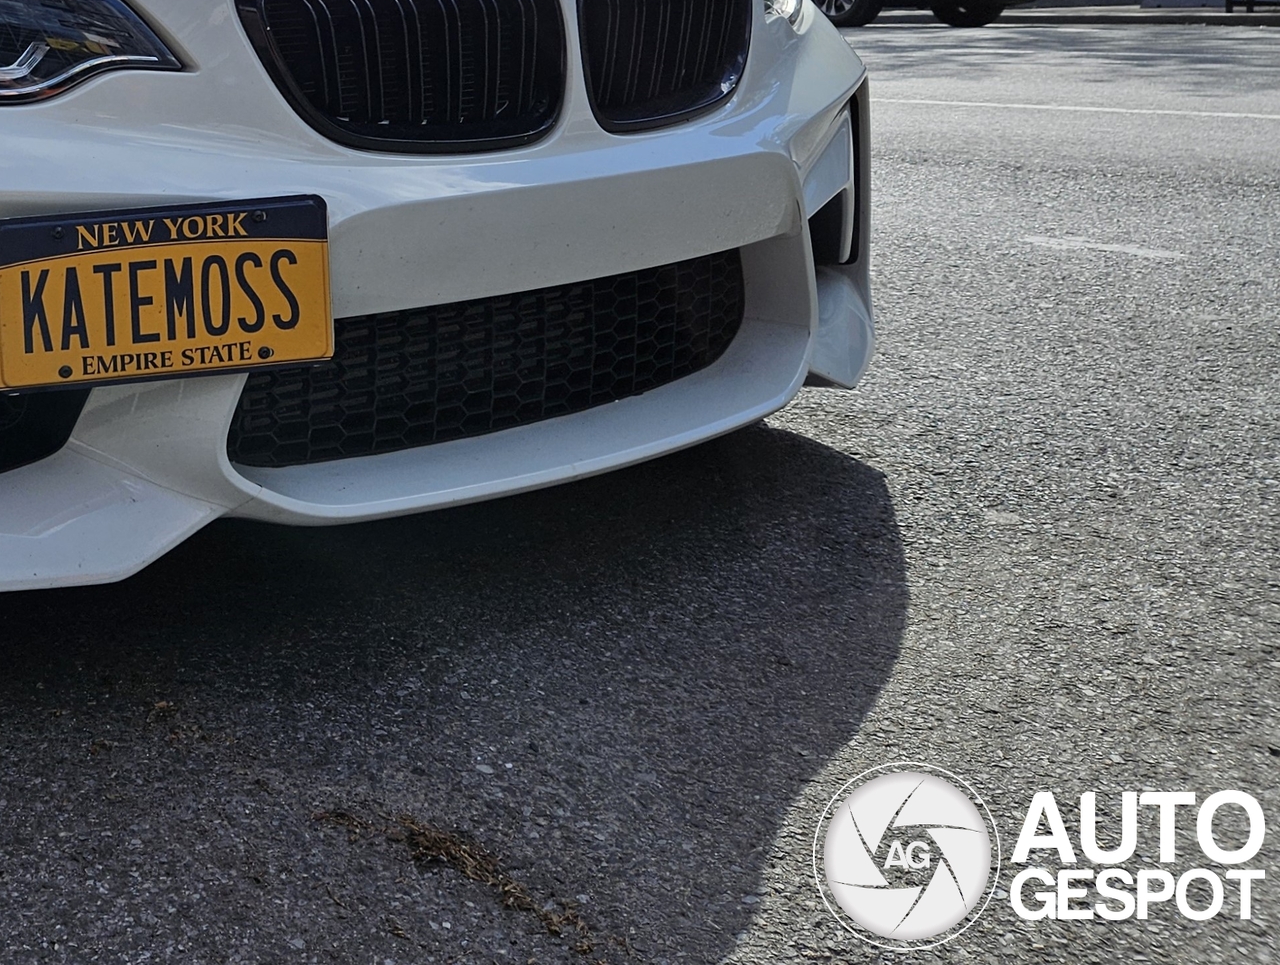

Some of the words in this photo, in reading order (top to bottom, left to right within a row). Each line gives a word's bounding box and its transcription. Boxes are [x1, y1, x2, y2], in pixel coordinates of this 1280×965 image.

[76, 220, 155, 250] NEW
[163, 212, 248, 239] YORK
[20, 248, 301, 355] KATEMOSS
[81, 350, 174, 376] EMPIRE
[181, 340, 253, 366] STATE
